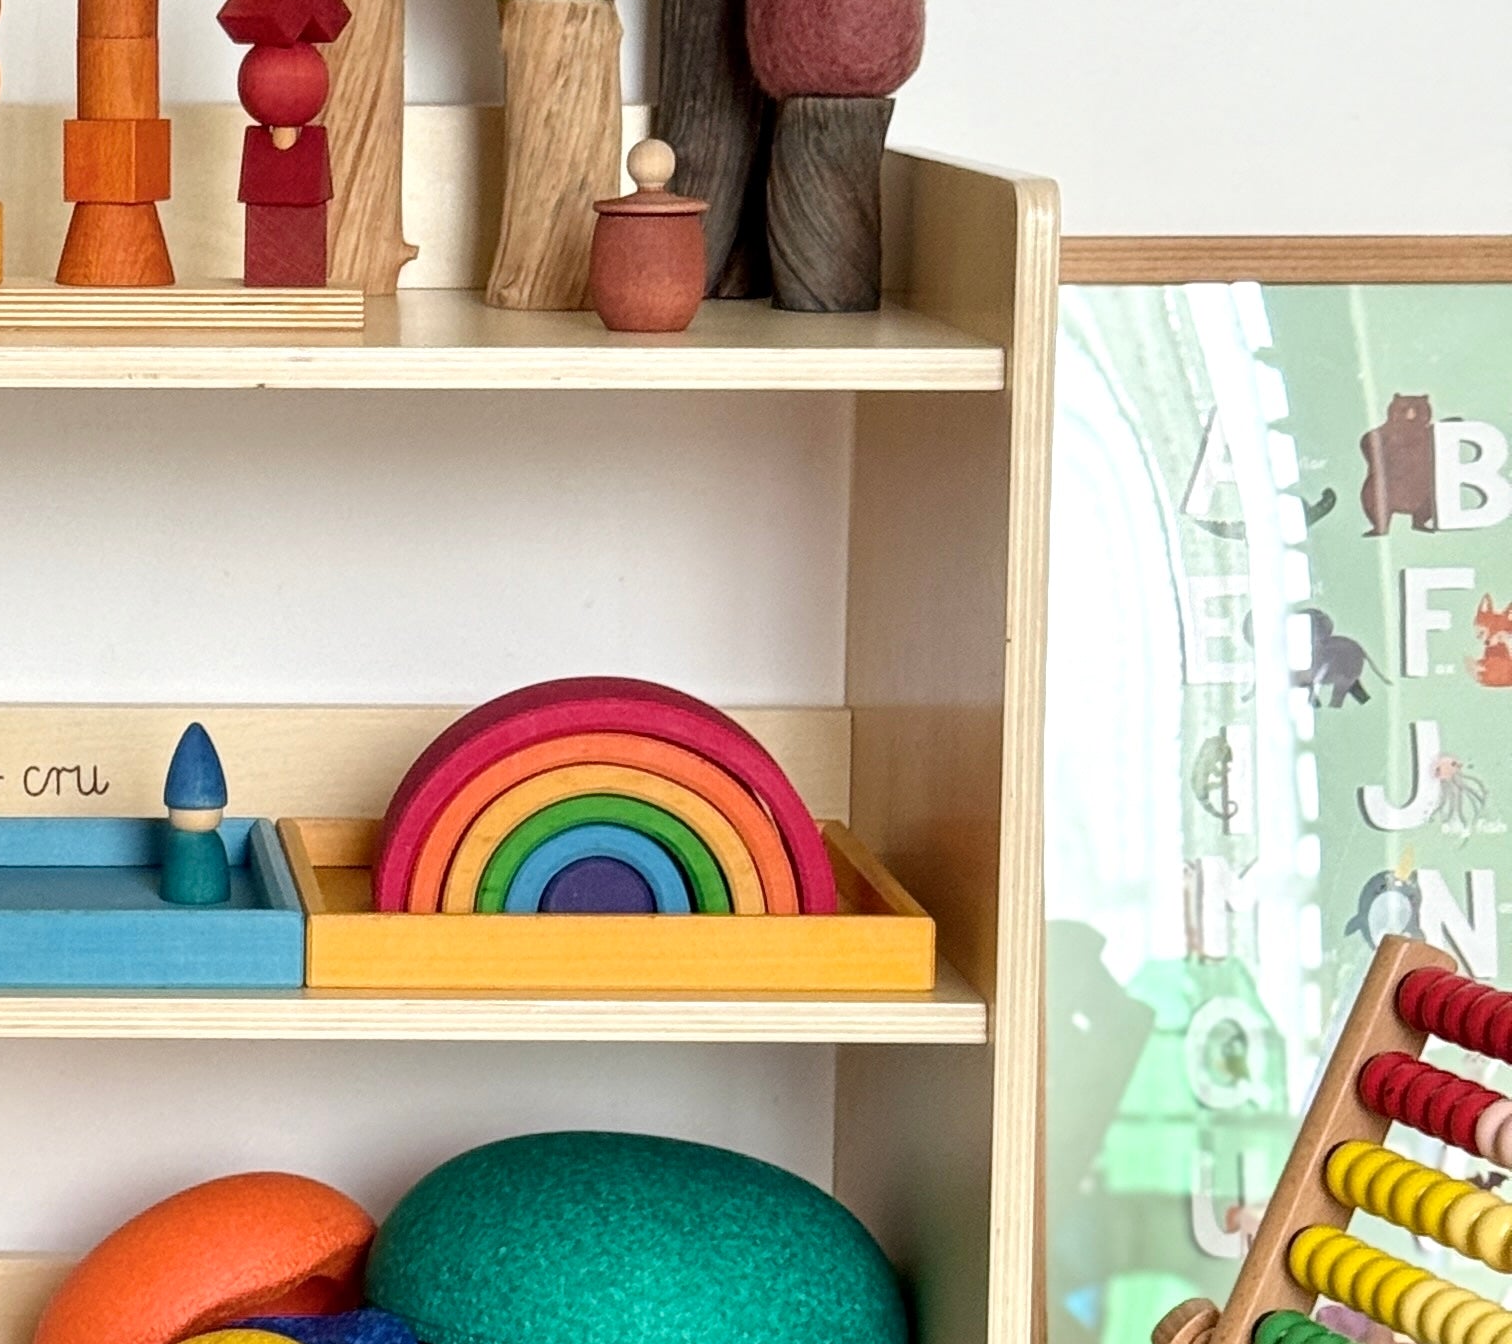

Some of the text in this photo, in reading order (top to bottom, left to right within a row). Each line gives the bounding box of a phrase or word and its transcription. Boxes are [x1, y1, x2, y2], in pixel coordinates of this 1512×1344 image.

[1432, 419, 1512, 531] B
[1399, 567, 1475, 677] F
[23, 765, 110, 797] cru
[1357, 720, 1439, 833] J
[1416, 868, 1498, 981] N
[1187, 997, 1272, 1110] Q
